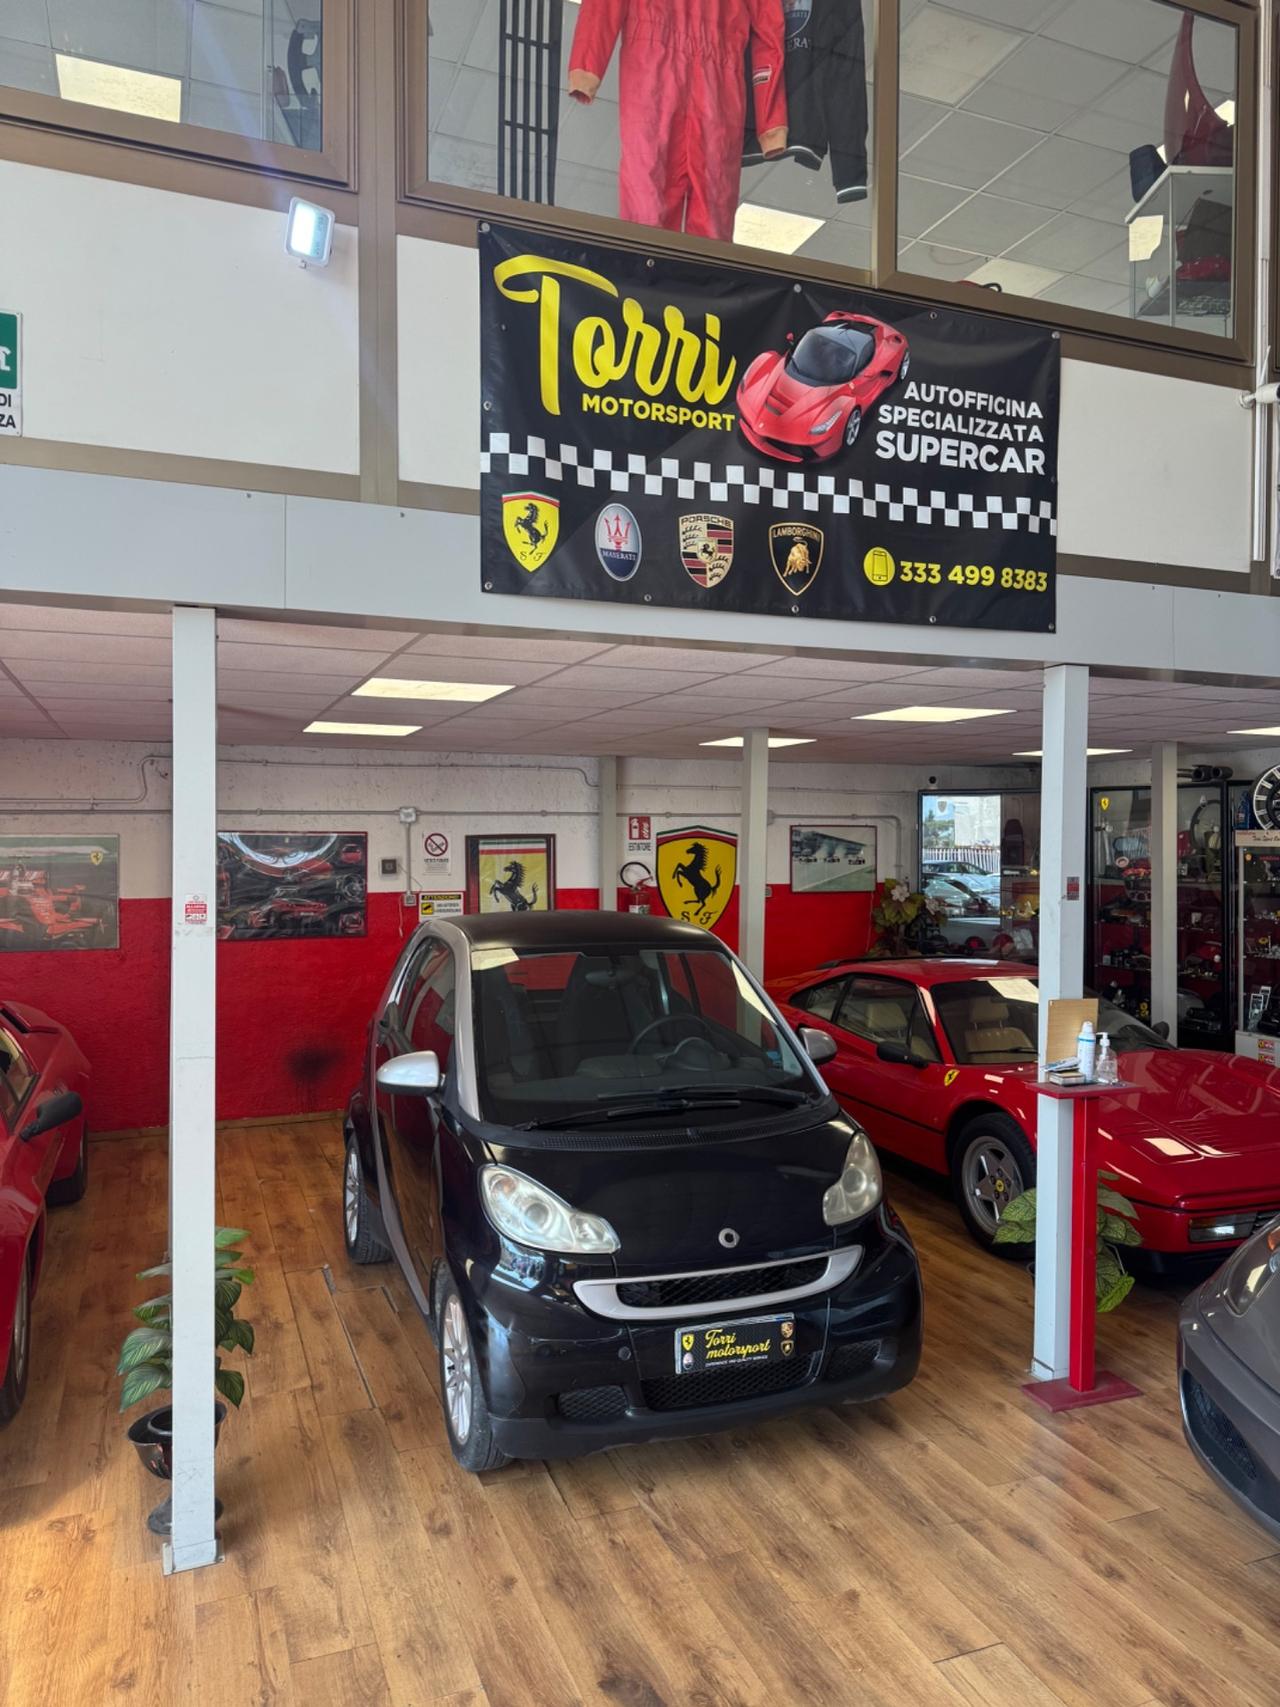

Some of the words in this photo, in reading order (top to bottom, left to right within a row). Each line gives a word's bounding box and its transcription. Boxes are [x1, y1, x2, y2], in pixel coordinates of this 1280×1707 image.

[493, 254, 737, 416] Torri
[582, 393, 735, 431] MOTORSPORT
[904, 381, 1043, 419] AUTOFFICINA
[878, 404, 1044, 442] SPECIALIZZATA
[875, 430, 1046, 475] SUPERCAR
[681, 515, 732, 528] PORSCHE
[772, 526, 821, 542] LAMBORGHINI
[602, 550, 636, 561] MASERATI
[900, 560, 941, 584] 333
[948, 565, 995, 586] 499
[1001, 567, 1048, 592] 8383
[705, 1328, 737, 1349] Torri
[706, 1338, 771, 1359] motorsport
